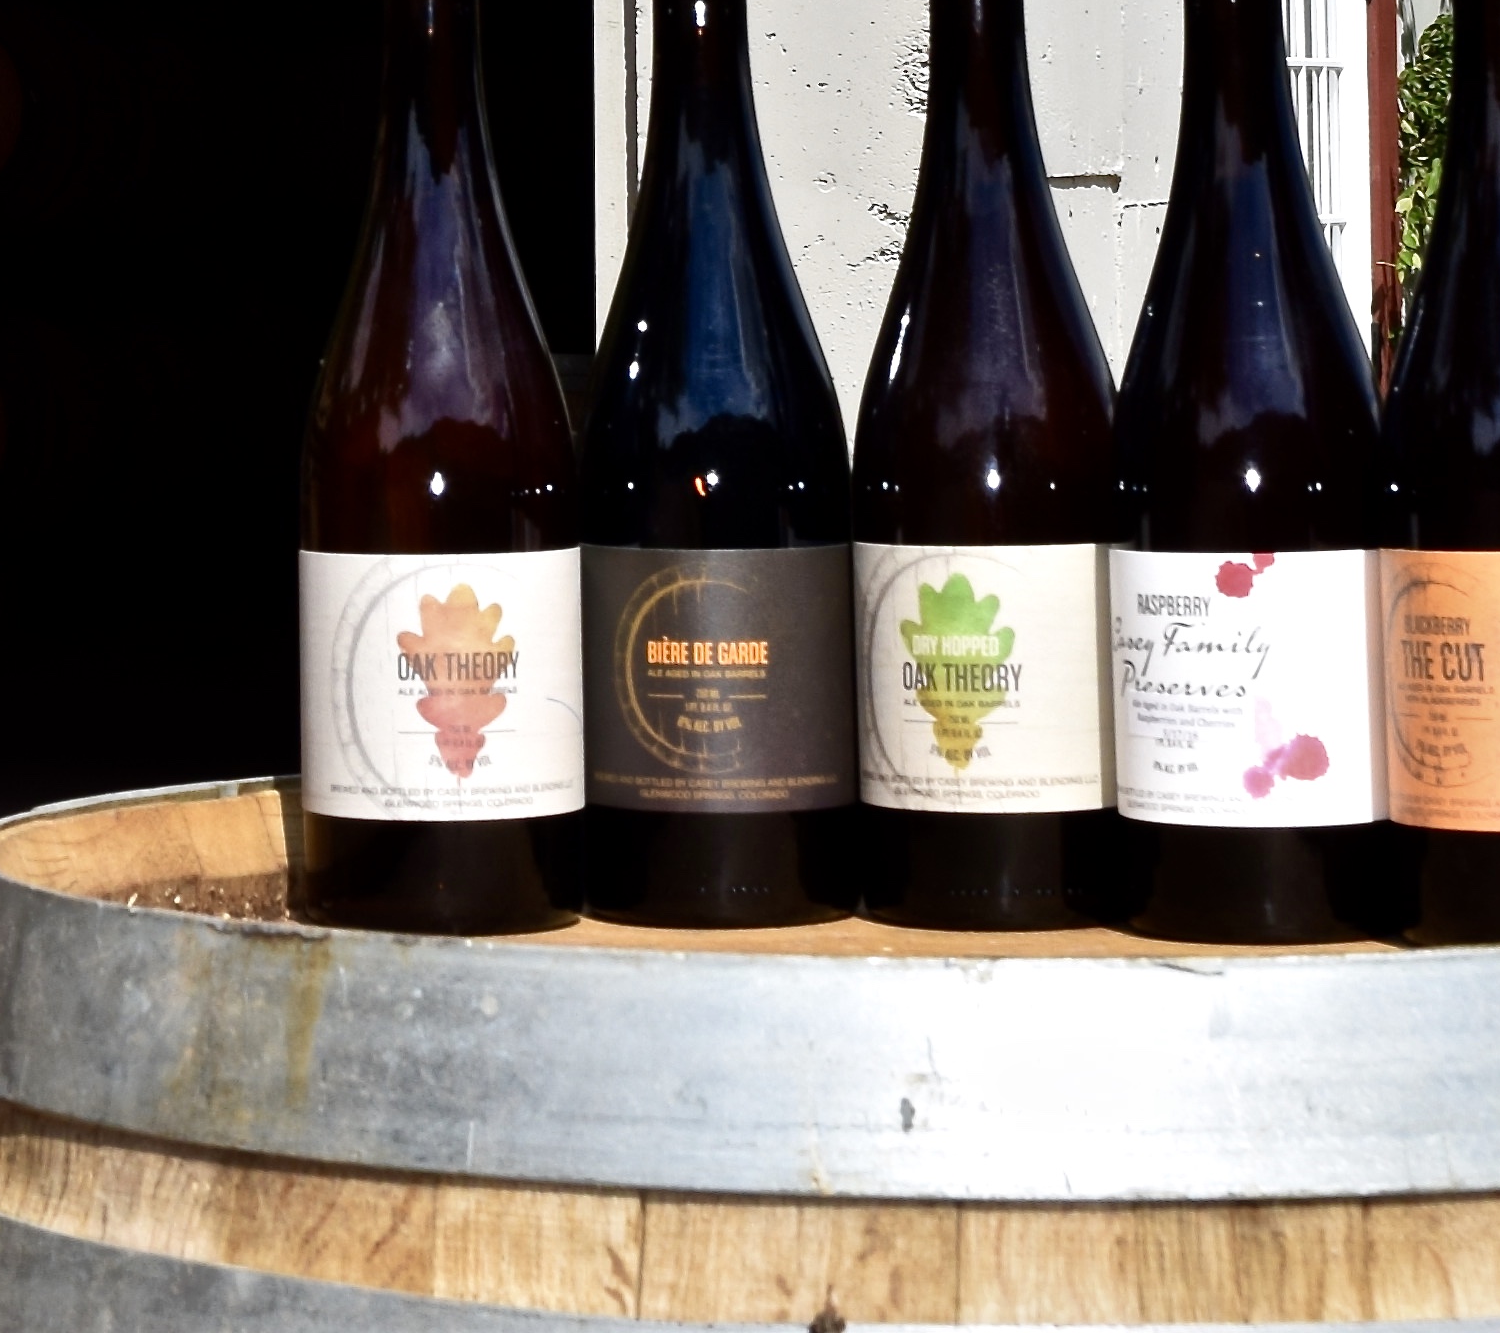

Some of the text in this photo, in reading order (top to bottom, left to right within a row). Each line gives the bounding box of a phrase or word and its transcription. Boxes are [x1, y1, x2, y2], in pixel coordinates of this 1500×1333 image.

[1137, 593, 1212, 617] RASPBERRY
[647, 636, 769, 664] BIÈRE DE GARDE
[912, 634, 1001, 657] DRY HOPPED
[1163, 622, 1271, 680] Family
[1400, 639, 1486, 682] THE CUT
[397, 650, 520, 681] OAK THEORY
[902, 661, 1023, 693] OAK THEORY
[1120, 658, 1247, 698] Preserves
